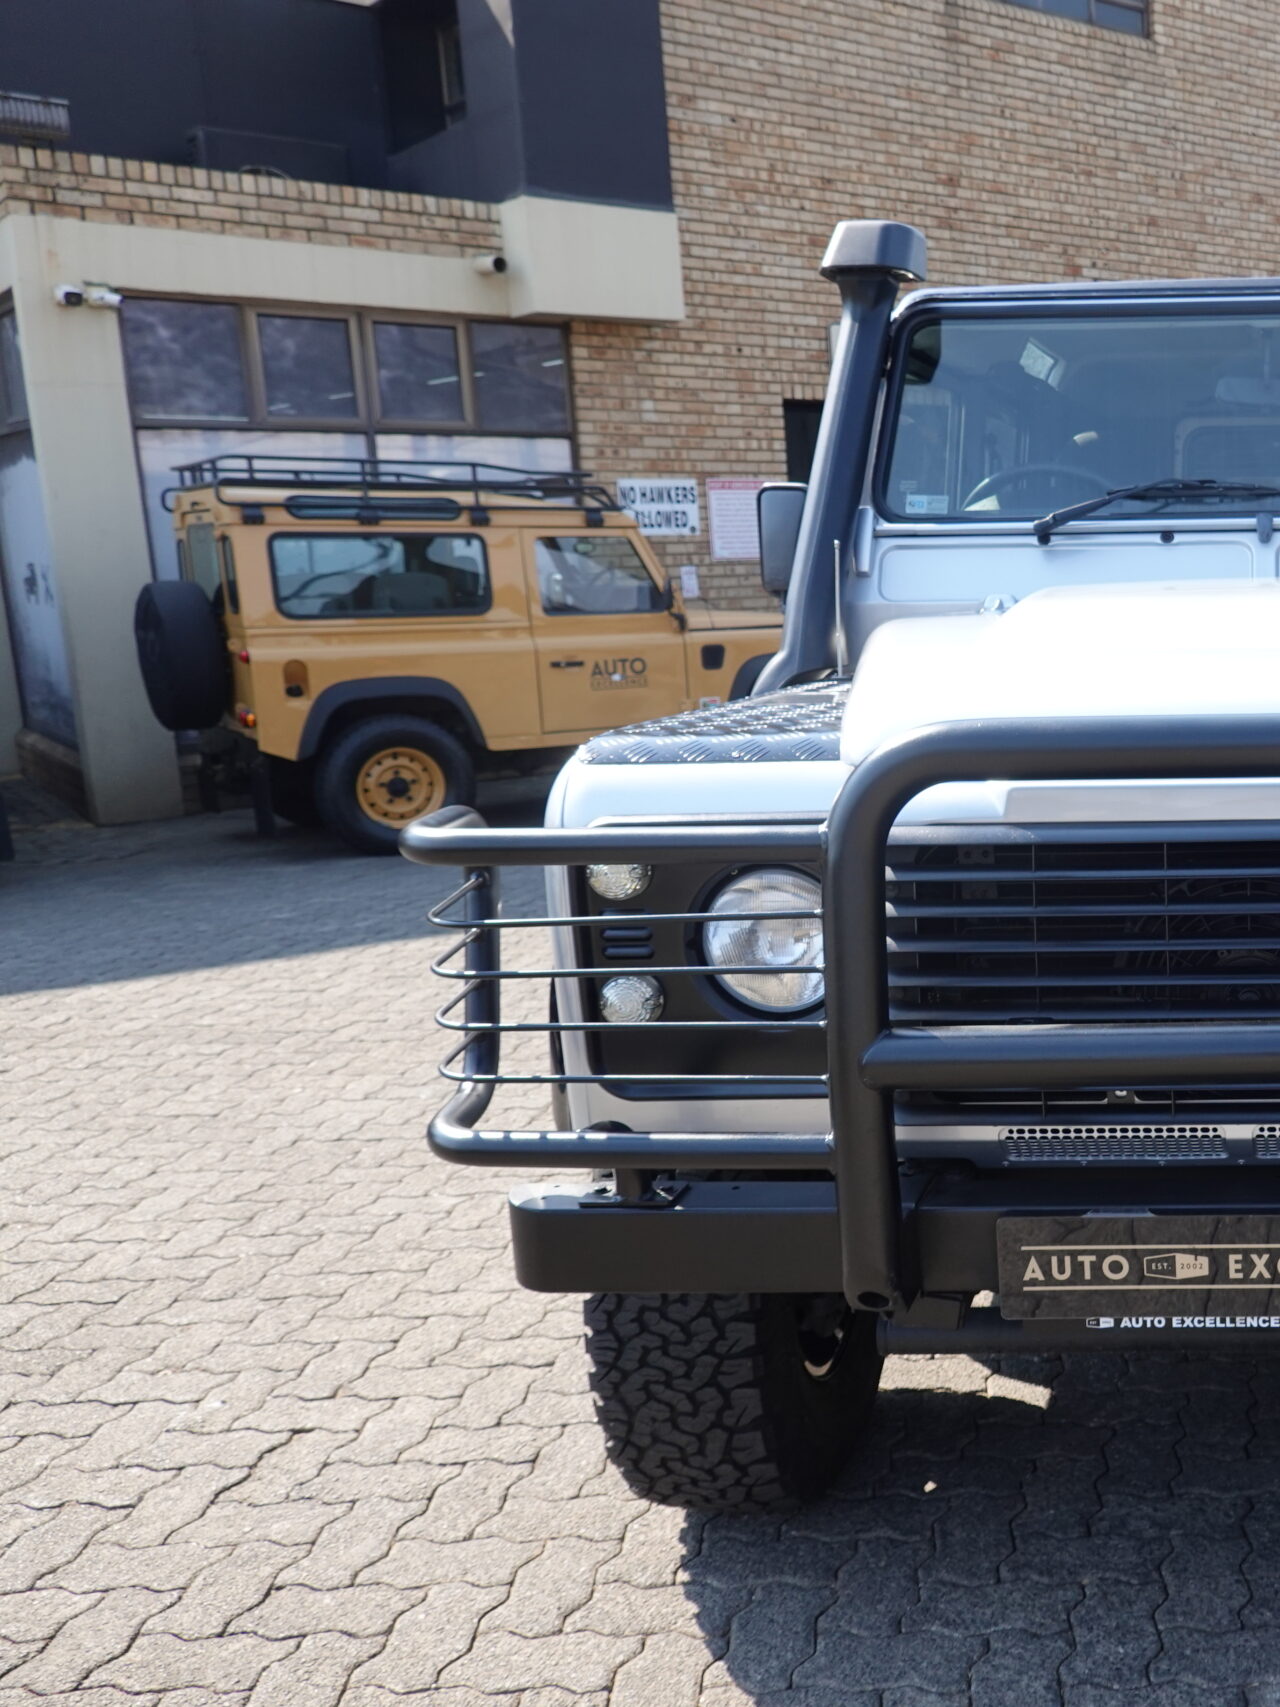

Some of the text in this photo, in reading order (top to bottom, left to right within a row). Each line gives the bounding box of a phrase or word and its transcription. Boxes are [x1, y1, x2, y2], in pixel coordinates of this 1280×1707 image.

[620, 486, 695, 505] NO HAWKERS
[591, 657, 647, 677] AUTO
[1022, 1254, 1130, 1281] AUTO
[1151, 1262, 1172, 1270] EST.
[1180, 1262, 1203, 1270] 2002
[1120, 1316, 1166, 1328] AUTO
[1172, 1316, 1280, 1328] EXCELLENCE
